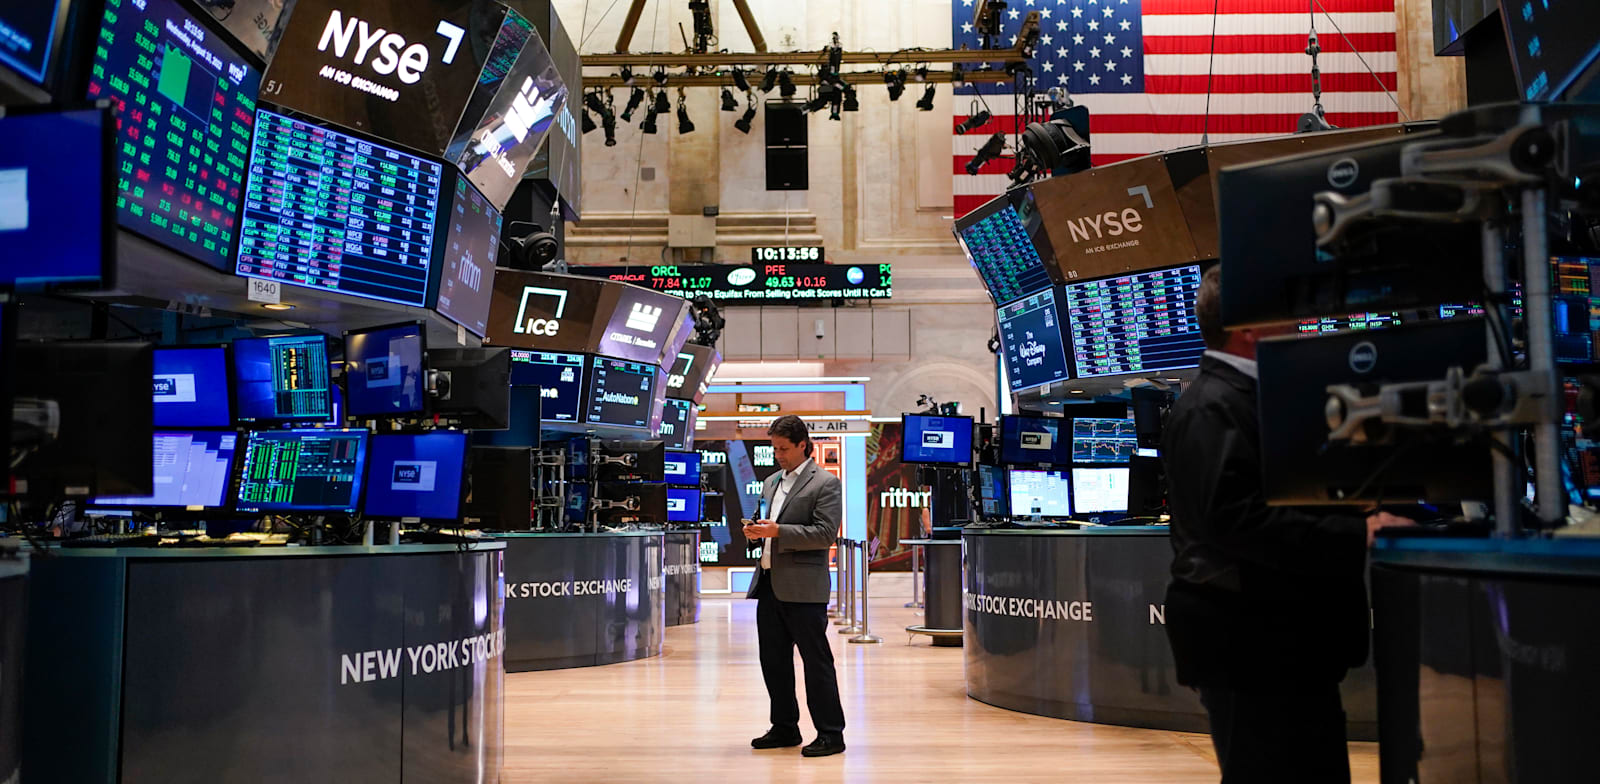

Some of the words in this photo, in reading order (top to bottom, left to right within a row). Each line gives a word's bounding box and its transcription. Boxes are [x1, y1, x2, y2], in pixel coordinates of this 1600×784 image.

[318, 65, 334, 78] AN
[756, 248, 819, 260] 10:13:56
[609, 274, 646, 282] ORACLE
[651, 266, 681, 277] ORCL
[765, 265, 786, 275] PFE
[253, 281, 276, 295] 1640
[652, 278, 680, 288] 77.84
[690, 277, 712, 288] 1.07
[765, 277, 795, 287] 49.63
[804, 277, 827, 287] 0.16
[685, 290, 694, 299] to
[714, 290, 743, 300] Equifax
[744, 290, 764, 298] From
[765, 289, 791, 299] Selling
[792, 289, 816, 298] Credit
[817, 289, 842, 298] Scores
[843, 289, 861, 298] Until
[862, 289, 870, 297] It
[870, 288, 885, 297] Can
[1026, 331, 1034, 340] The
[1027, 340, 1046, 358] Disney
[1026, 356, 1043, 366] Company
[602, 392, 635, 405] AutoNation
[826, 422, 848, 431] AIR
[520, 581, 570, 597] STOCK
[573, 579, 632, 595] EXCHANGE
[977, 595, 1007, 615] STOCK
[1009, 597, 1093, 622] EXCHANGE
[1149, 605, 1165, 625] N
[341, 648, 402, 685] NEW
[407, 640, 459, 674] YORK
[461, 631, 496, 666] STOCK
